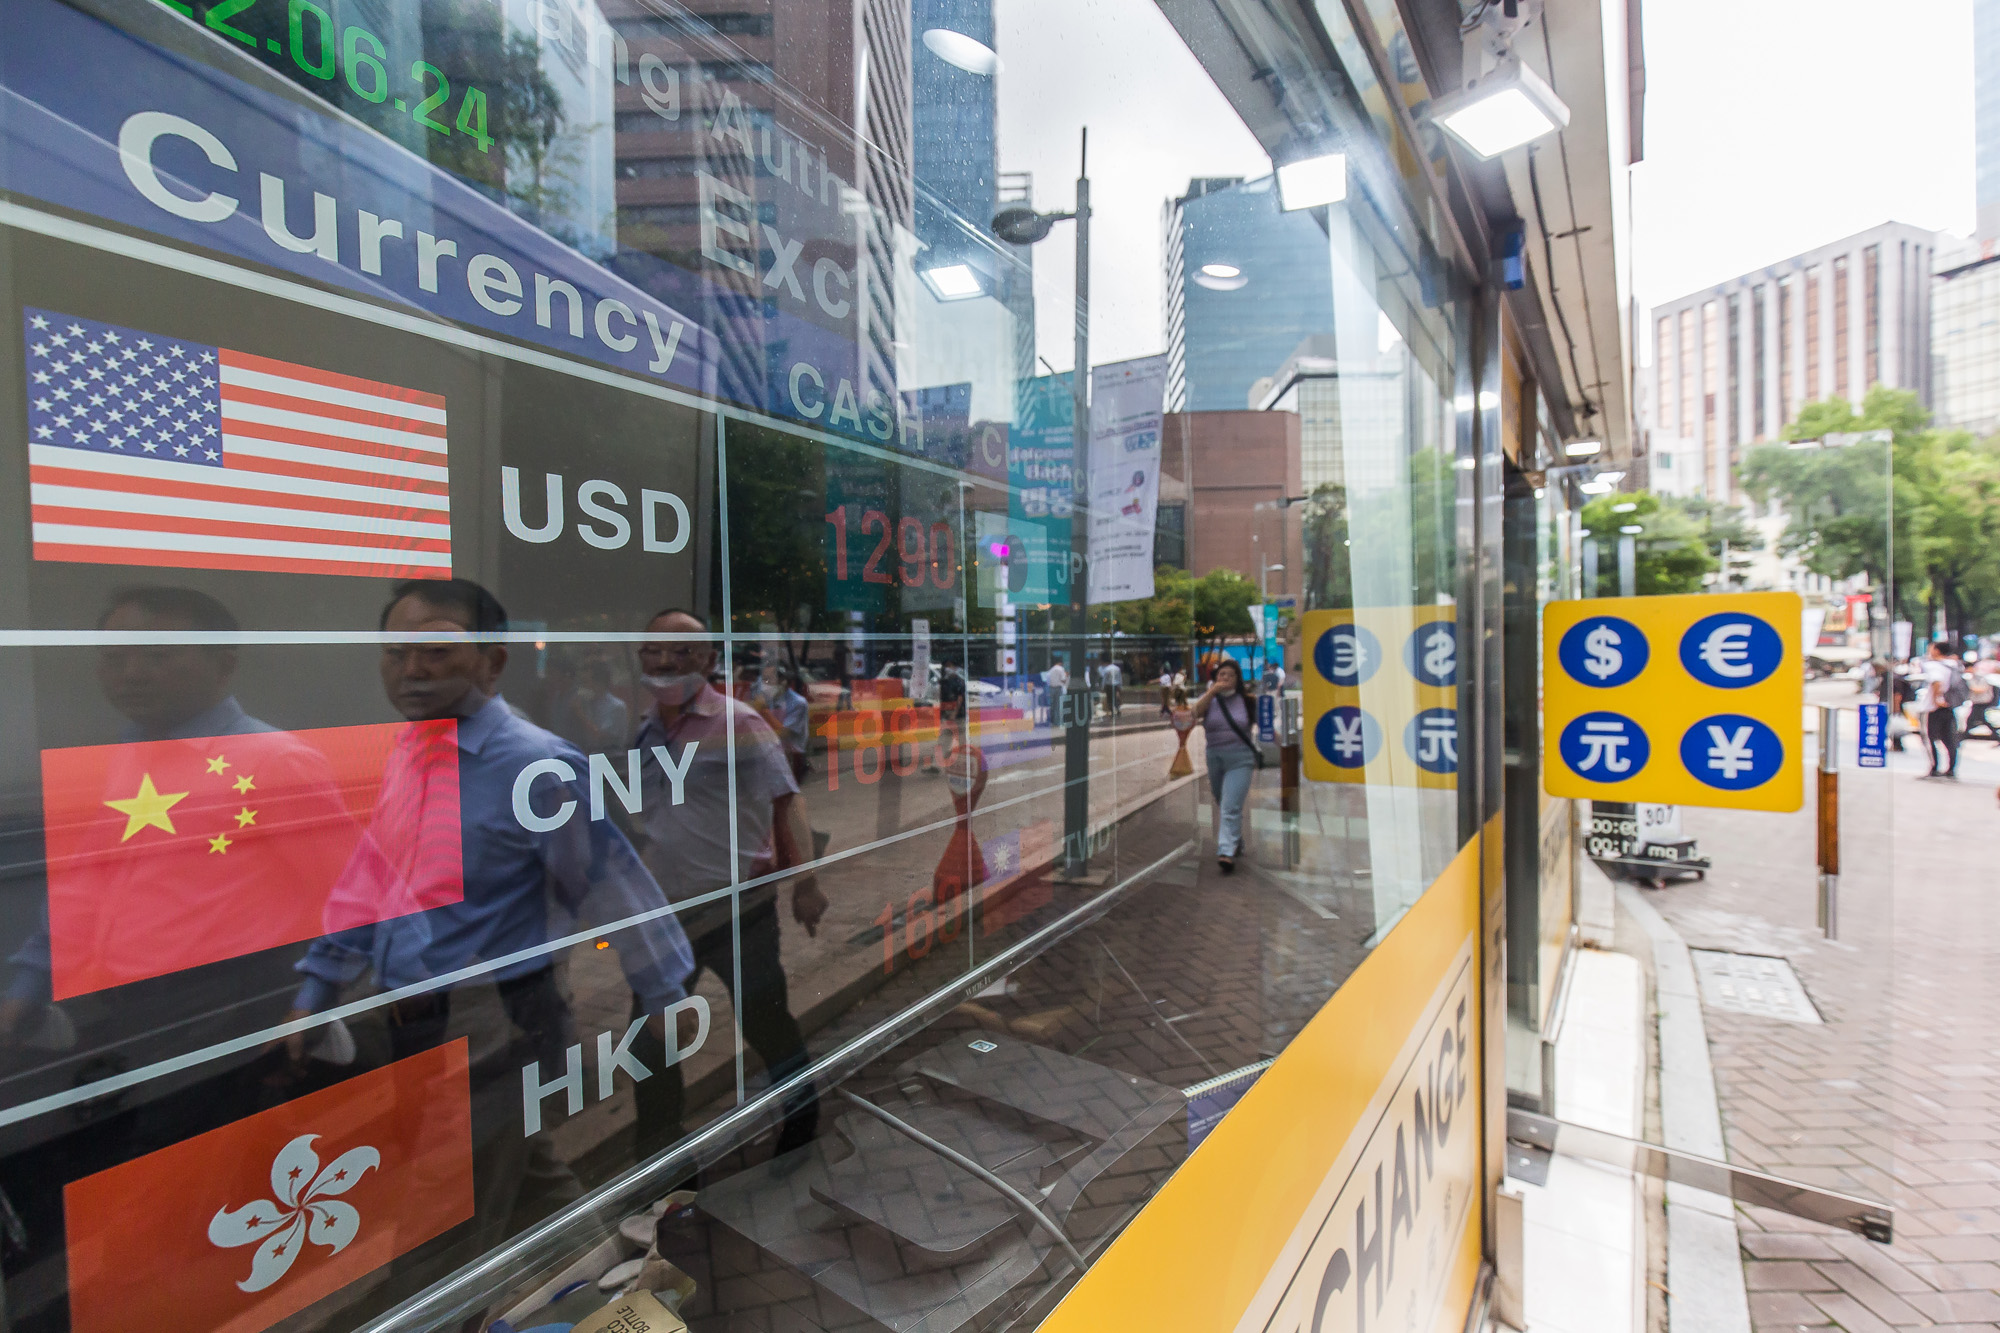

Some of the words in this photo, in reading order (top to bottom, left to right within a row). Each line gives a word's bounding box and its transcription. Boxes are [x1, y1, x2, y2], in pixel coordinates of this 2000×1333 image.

[119, 111, 684, 373] Currency
[788, 362, 925, 450] CASH
[501, 466, 691, 554] USD
[825, 505, 955, 589] 1290
[1056, 550, 1096, 587] JPY
[511, 742, 699, 832] CNY
[1577, 721, 1631, 772] 元
[1061, 820, 1110, 868] TWD
[875, 875, 961, 974] 160
[522, 995, 711, 1137] HKD
[1293, 995, 1466, 1333] HANGE
